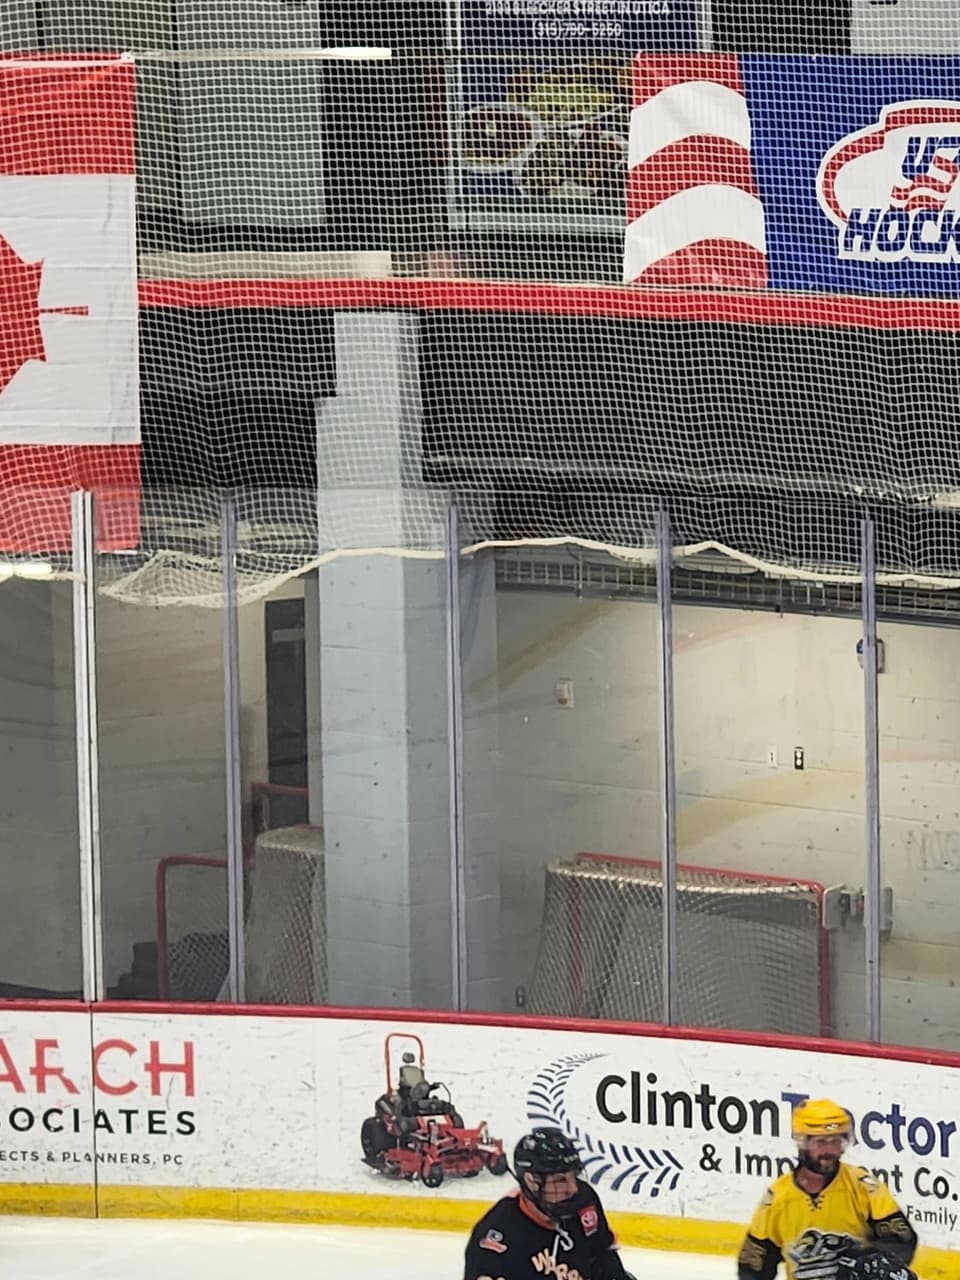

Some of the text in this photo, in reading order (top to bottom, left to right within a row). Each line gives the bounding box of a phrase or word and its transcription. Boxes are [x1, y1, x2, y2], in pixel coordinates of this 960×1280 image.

[46, 1151, 56, 1162] &
[163, 1154, 184, 1166] PC
[699, 1143, 722, 1173] &
[913, 1166, 958, 1202] Co.
[906, 1204, 958, 1232] Family
